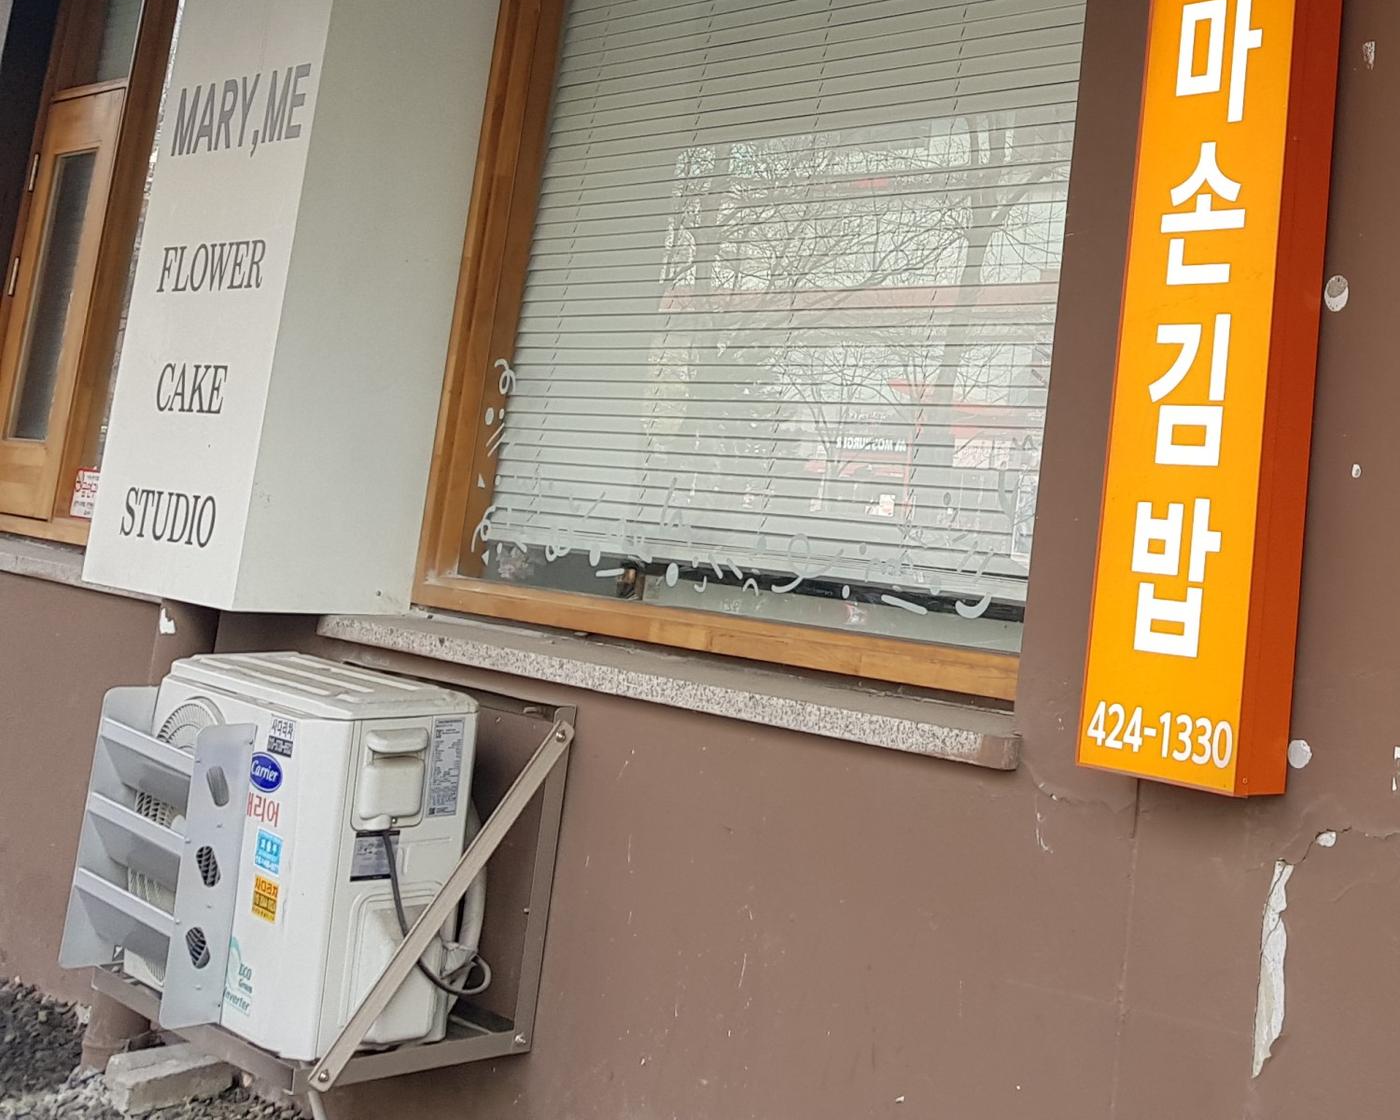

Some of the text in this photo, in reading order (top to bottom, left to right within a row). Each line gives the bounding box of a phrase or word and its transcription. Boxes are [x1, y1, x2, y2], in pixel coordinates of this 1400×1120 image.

[156, 239, 267, 293] FLOWER
[156, 363, 228, 414] CAKE
[119, 486, 217, 548] STUDIO
[1086, 700, 1235, 770] 424-1330
[251, 760, 279, 783] Carrier
